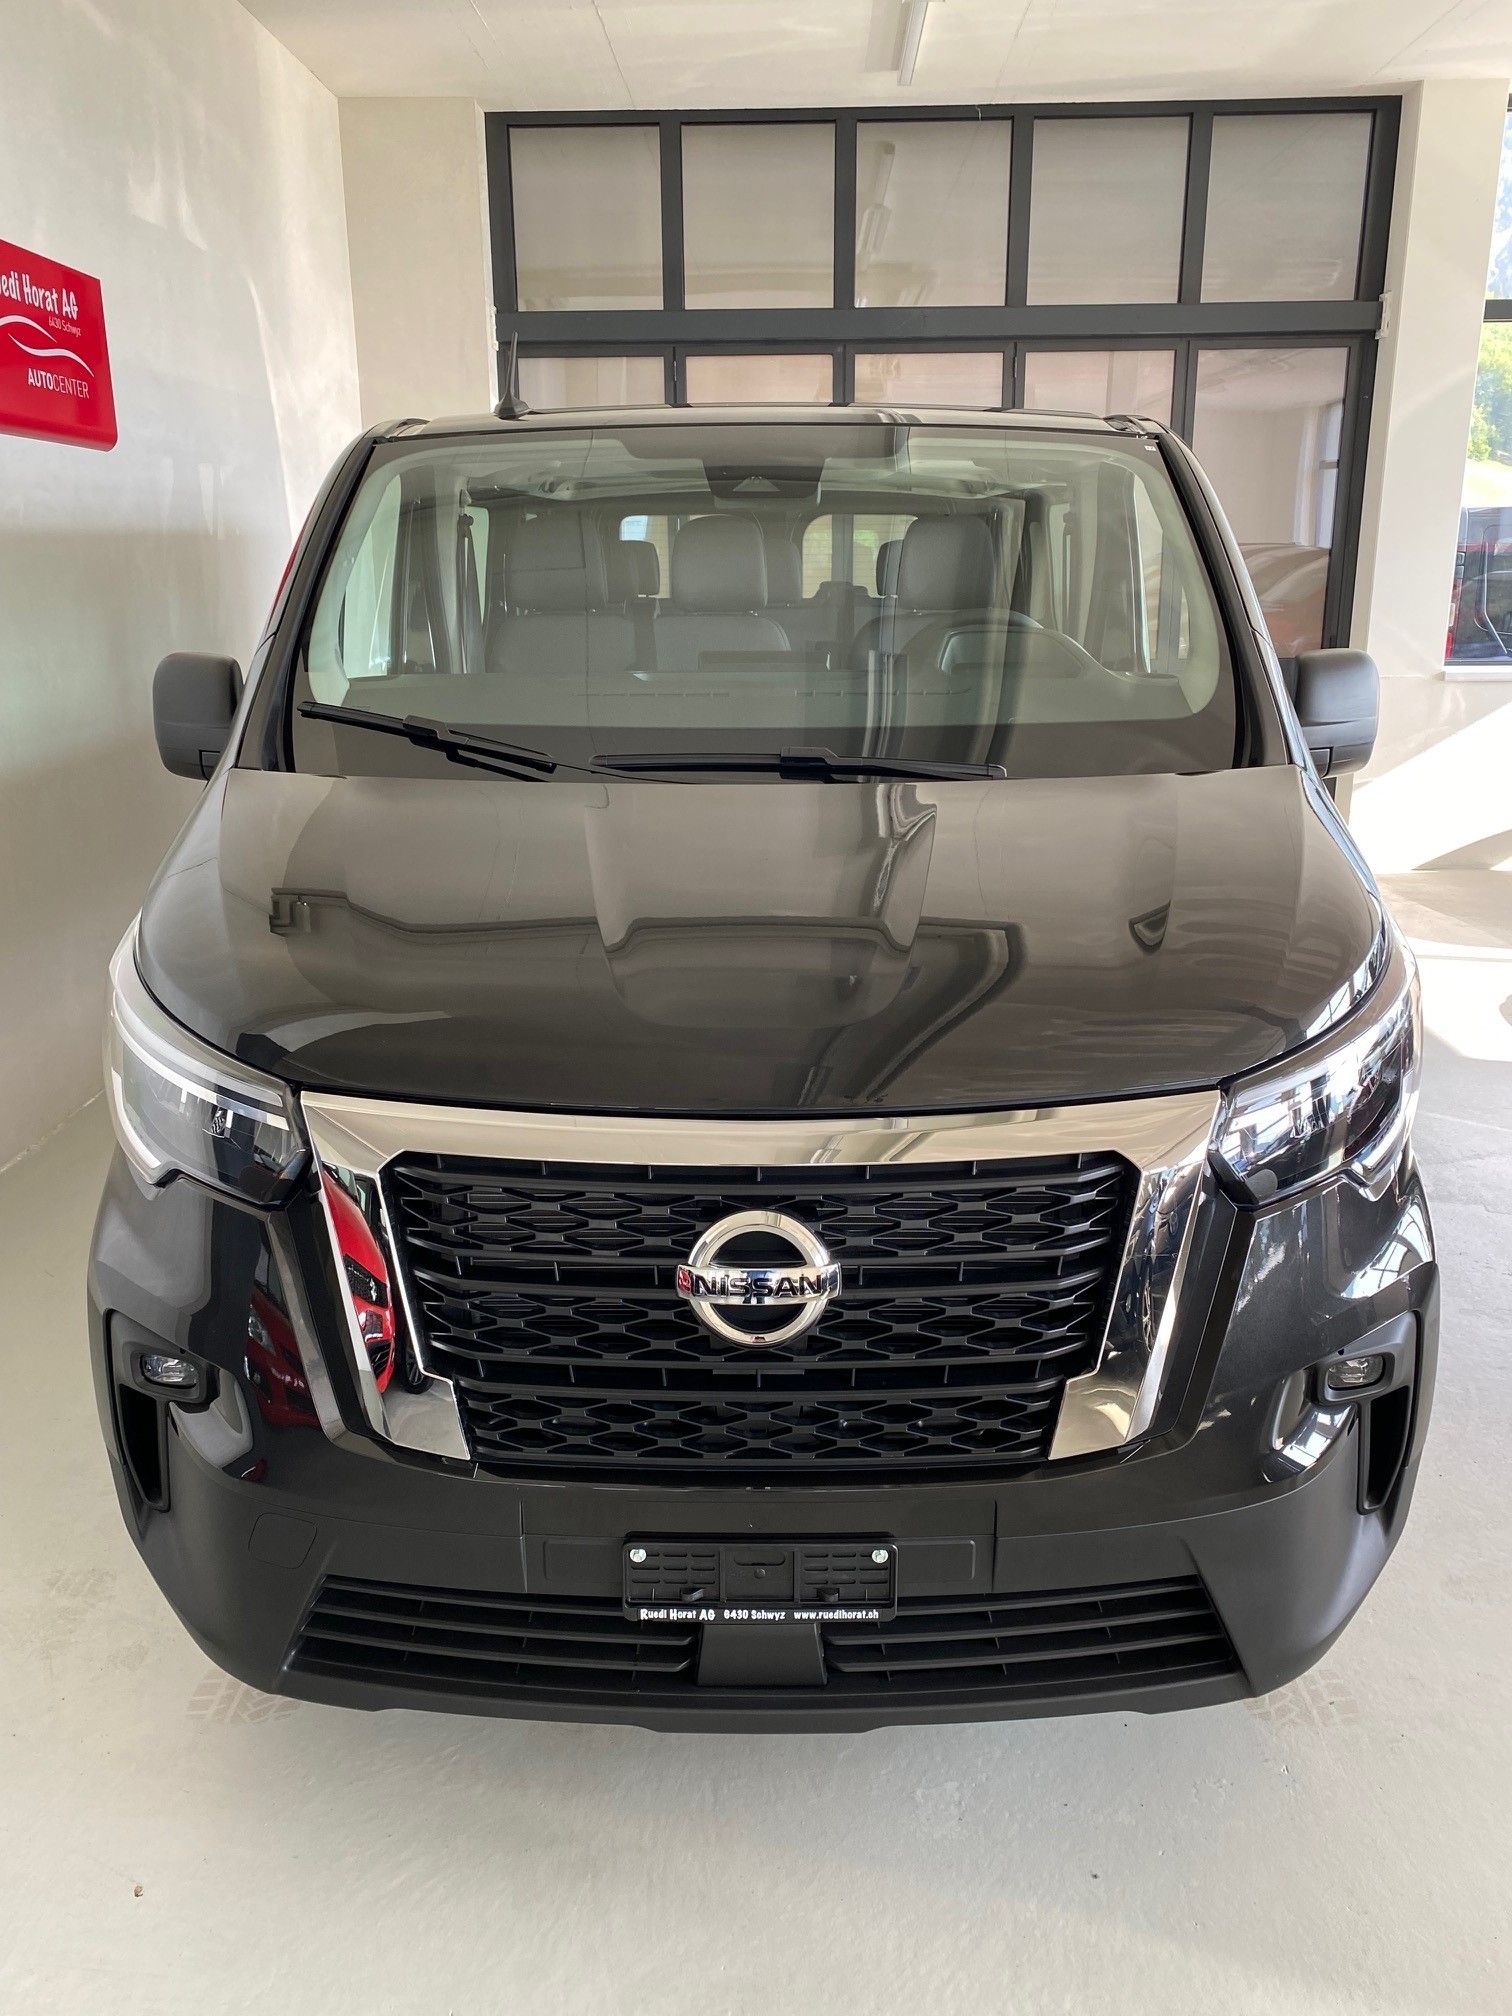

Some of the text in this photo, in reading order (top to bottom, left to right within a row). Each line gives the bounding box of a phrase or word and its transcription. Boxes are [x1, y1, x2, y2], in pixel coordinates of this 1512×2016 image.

[0, 270, 79, 320] edi Horat AG
[27, 367, 90, 399] AUTOCENTER
[693, 1272, 823, 1298] NISSAN
[640, 1608, 879, 1621] Ruedi Horat AG 6430 Schwyz www.ruedihorat.ch
